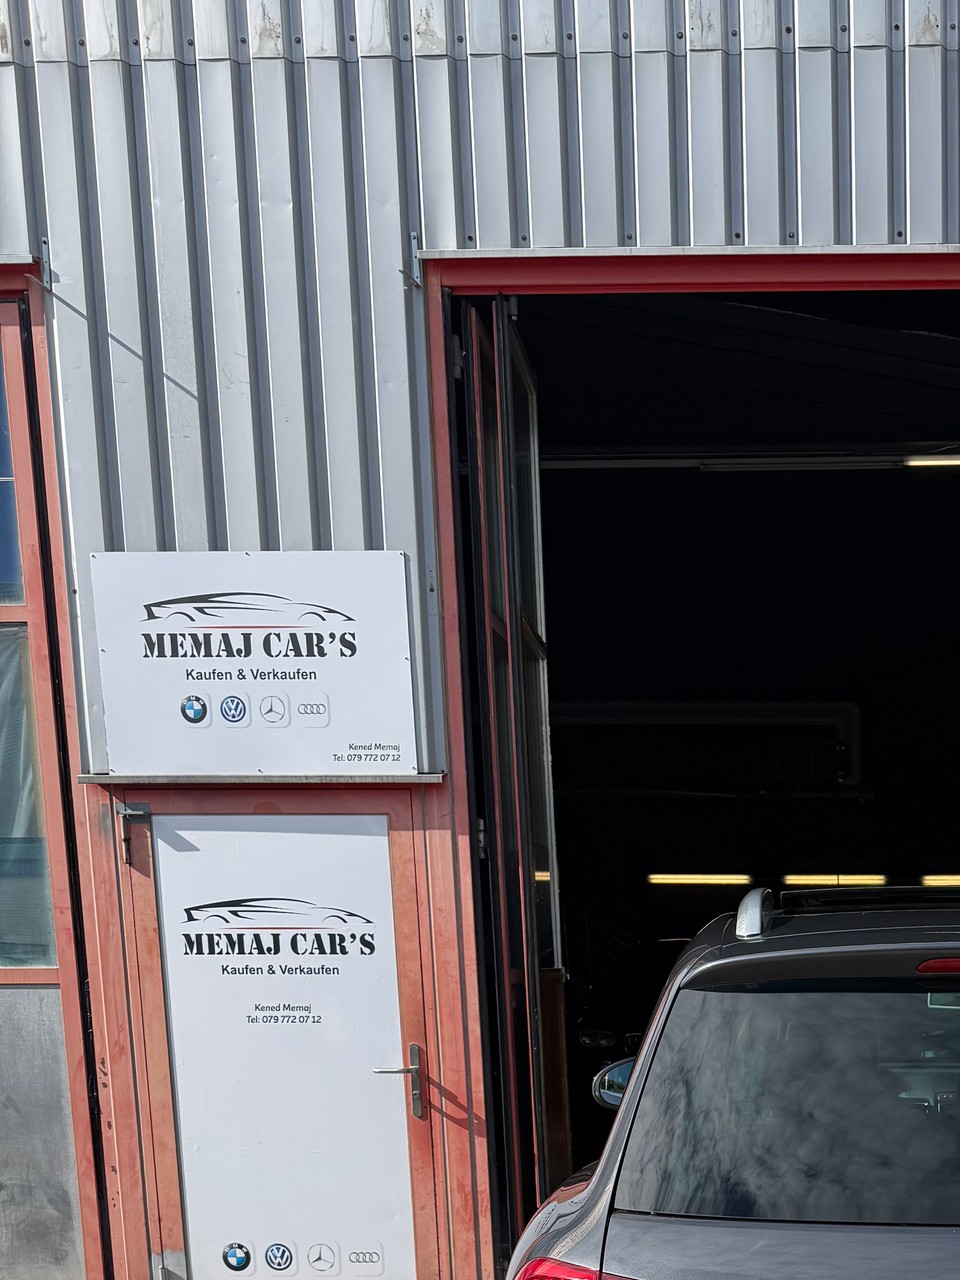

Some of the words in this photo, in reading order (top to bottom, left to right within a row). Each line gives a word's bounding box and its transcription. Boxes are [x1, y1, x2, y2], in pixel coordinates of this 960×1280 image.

[141, 632, 252, 658] MEMAJ
[263, 632, 357, 658] CAR'S
[186, 669, 232, 681] Kaufen
[237, 669, 247, 681] &
[250, 669, 317, 681] Verkaufen
[349, 743, 372, 751] Kened
[374, 743, 400, 752] Memaj
[182, 933, 281, 955] MEMAJ
[290, 933, 376, 955] CAR'S
[221, 965, 263, 975] Kaufen
[267, 965, 276, 975] &
[279, 965, 339, 975] Verkaufen
[254, 1004, 281, 1012] Kened
[283, 1004, 312, 1014] Memaj
[246, 1015, 260, 1024] Tel:
[262, 1015, 279, 1024] 079
[281, 1015, 296, 1024] 772
[298, 1015, 310, 1024] 07
[312, 1015, 322, 1024] 12
